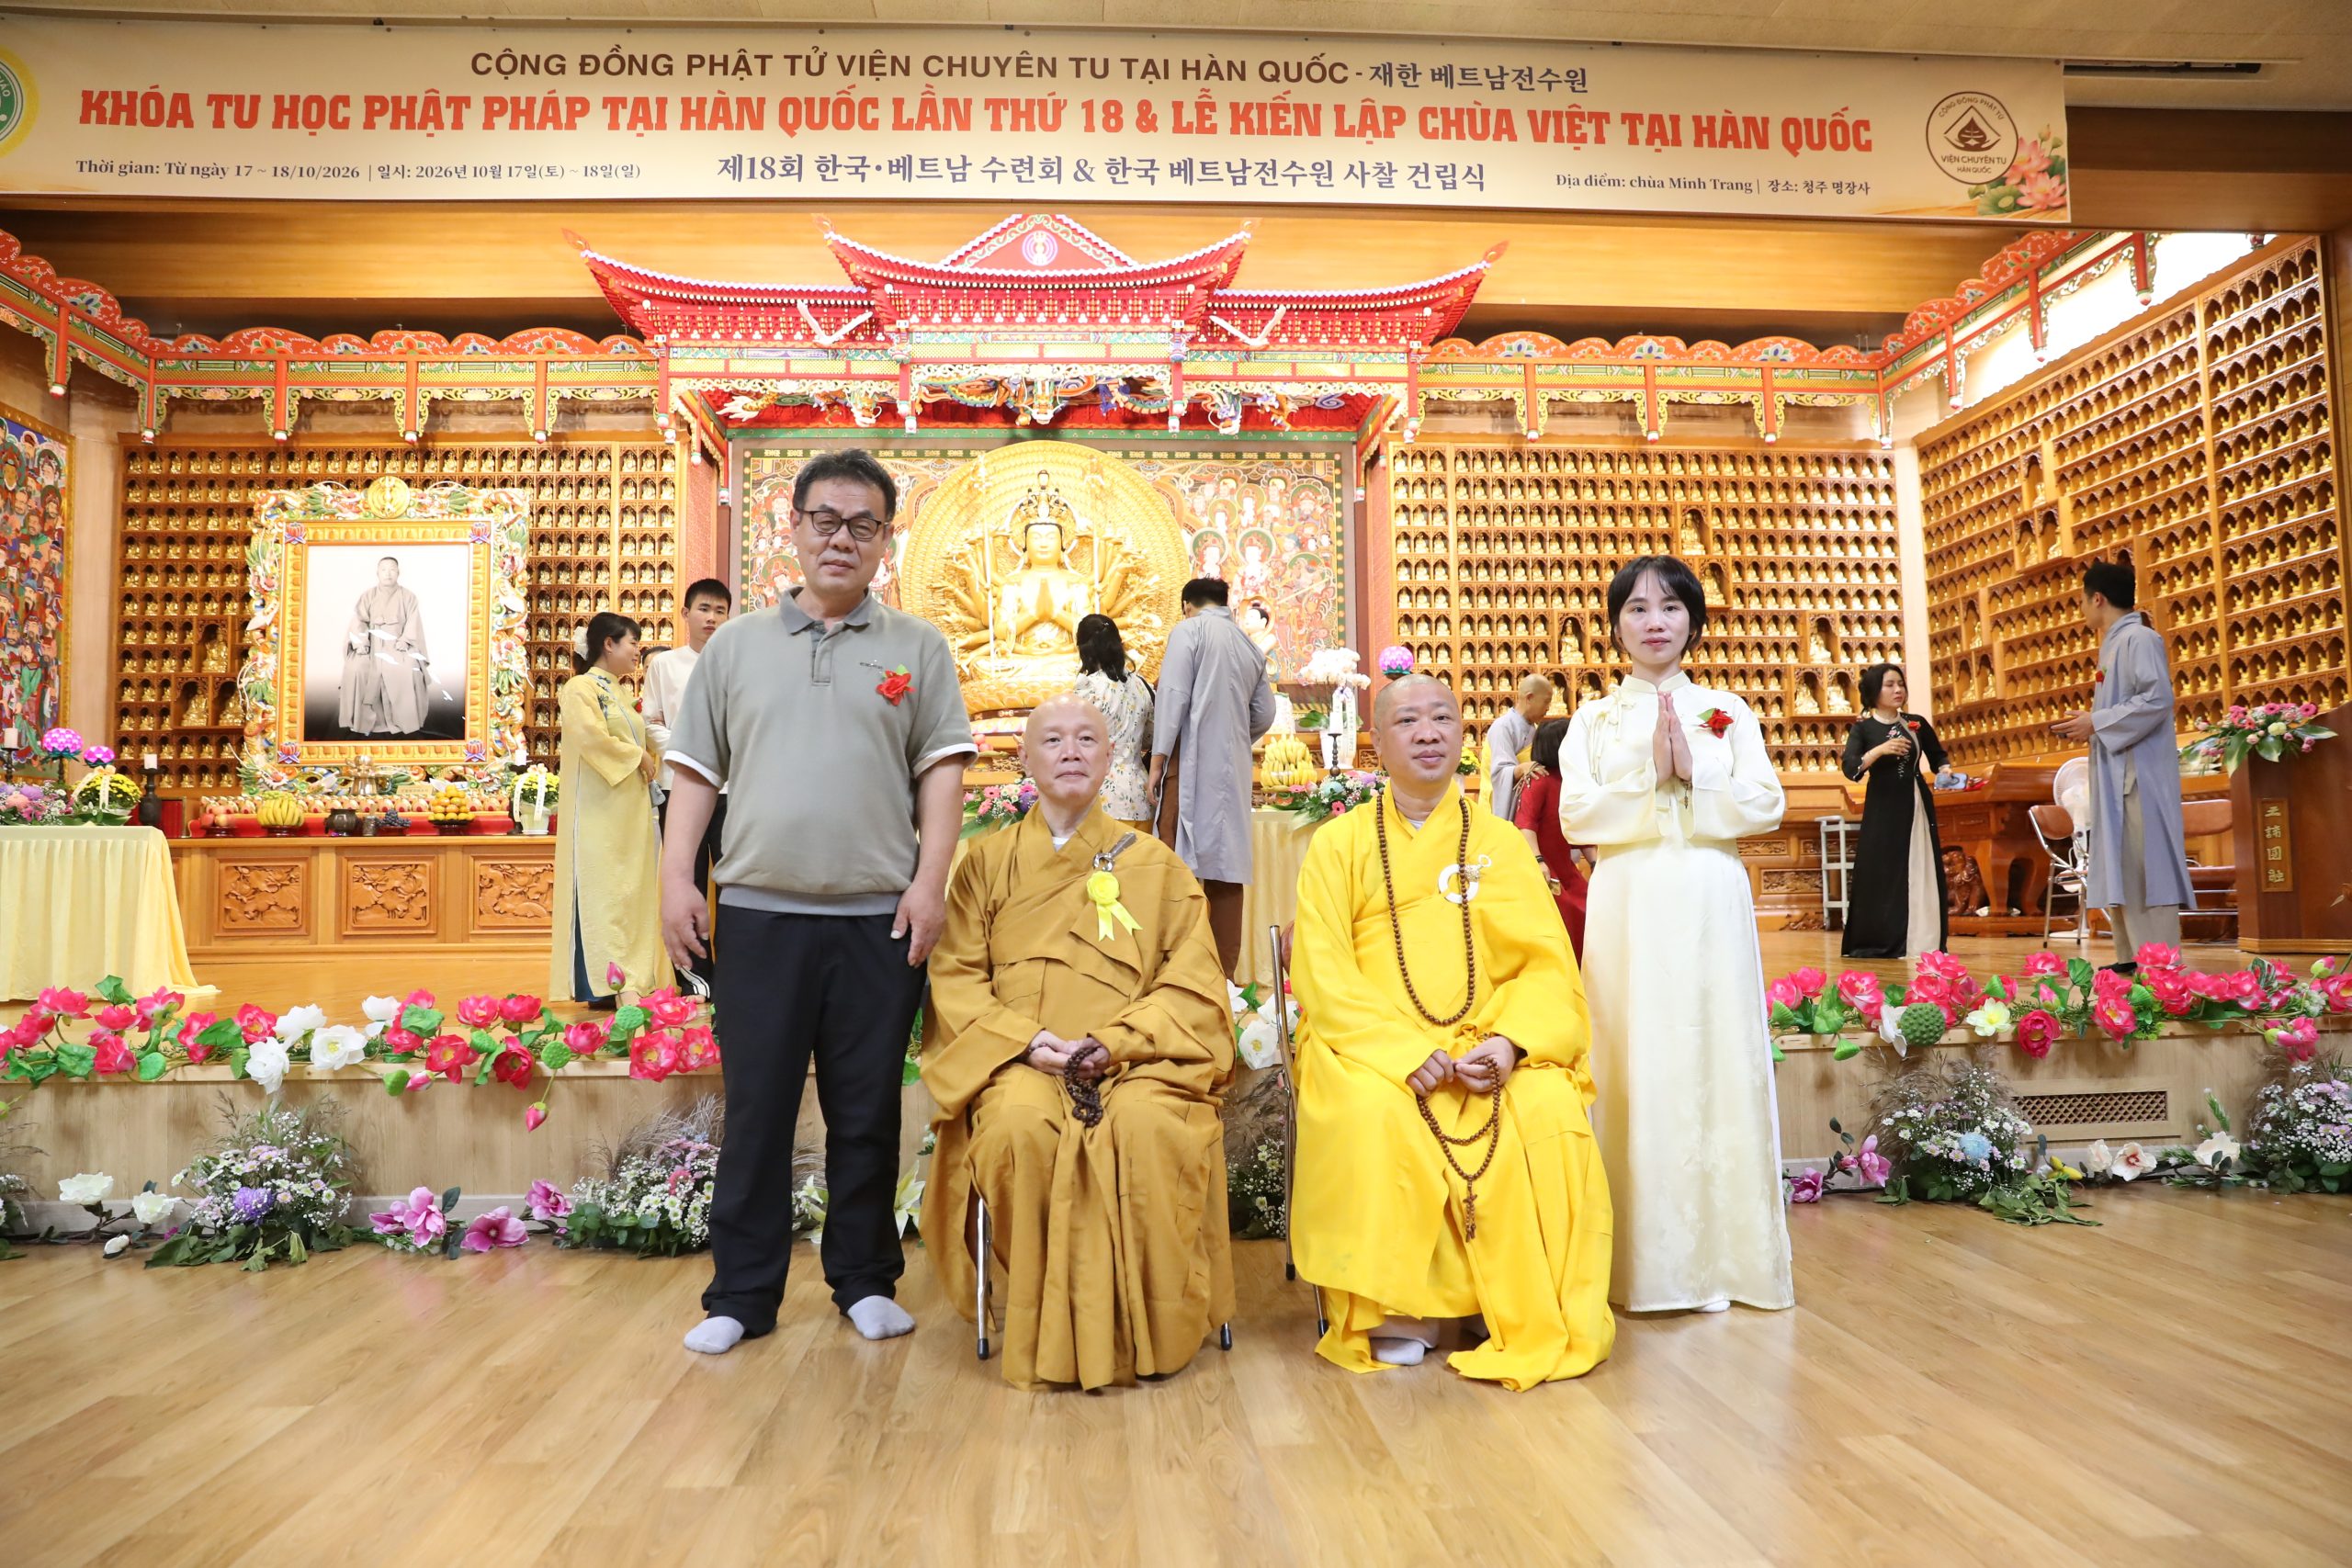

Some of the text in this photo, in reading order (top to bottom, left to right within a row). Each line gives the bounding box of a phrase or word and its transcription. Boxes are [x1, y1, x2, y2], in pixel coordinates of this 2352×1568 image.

[471, 48, 566, 80] CỘNG
[579, 44, 673, 76] ĐỒNG
[687, 49, 773, 81] PHẬT
[784, 46, 828, 76] TỬ
[836, 49, 910, 81] VIỆN
[923, 51, 1057, 78] CHUYÊN
[1069, 57, 1109, 79] TU
[1120, 58, 1169, 85] TẠI
[1182, 53, 1246, 81] HÀN
[1259, 52, 1349, 84] QUỐC
[1369, 62, 1588, 93] 재한 베트남전수원
[79, 84, 1871, 158] KHÓA TU HỌC PHẬT PHÁP TẠI HÀN QUỐC LẦN THỨ 18 & LỄ KIẾN LẬP CHÙA VIỆT TẠI HÀN QUỐC
[1940, 154, 2007, 164] VIỆN CHUYÊN TU
[76, 160, 114, 173] Thời
[119, 161, 159, 176] gian:
[164, 162, 187, 175] Từ
[190, 163, 230, 179] ngày
[235, 165, 253, 176] 17
[272, 165, 359, 180] 18/10/2026
[378, 164, 411, 179] 일시:
[416, 164, 467, 179] 2026년
[473, 164, 502, 179] 10월
[508, 164, 564, 179] 17일(토)
[584, 164, 640, 178] 18일(일)
[718, 154, 803, 183] 제18회
[980, 155, 1061, 185] 수련회
[1073, 159, 1095, 182] &
[1104, 156, 1160, 186] 한국
[1169, 157, 1334, 187] 베트남전수원
[1343, 161, 1398, 188] 사찰
[1407, 163, 1484, 192] 건립식
[1556, 173, 1753, 194] Địa điểm: chùa Minh Trang
[1768, 179, 1871, 196] 장소: 청주 명장사
